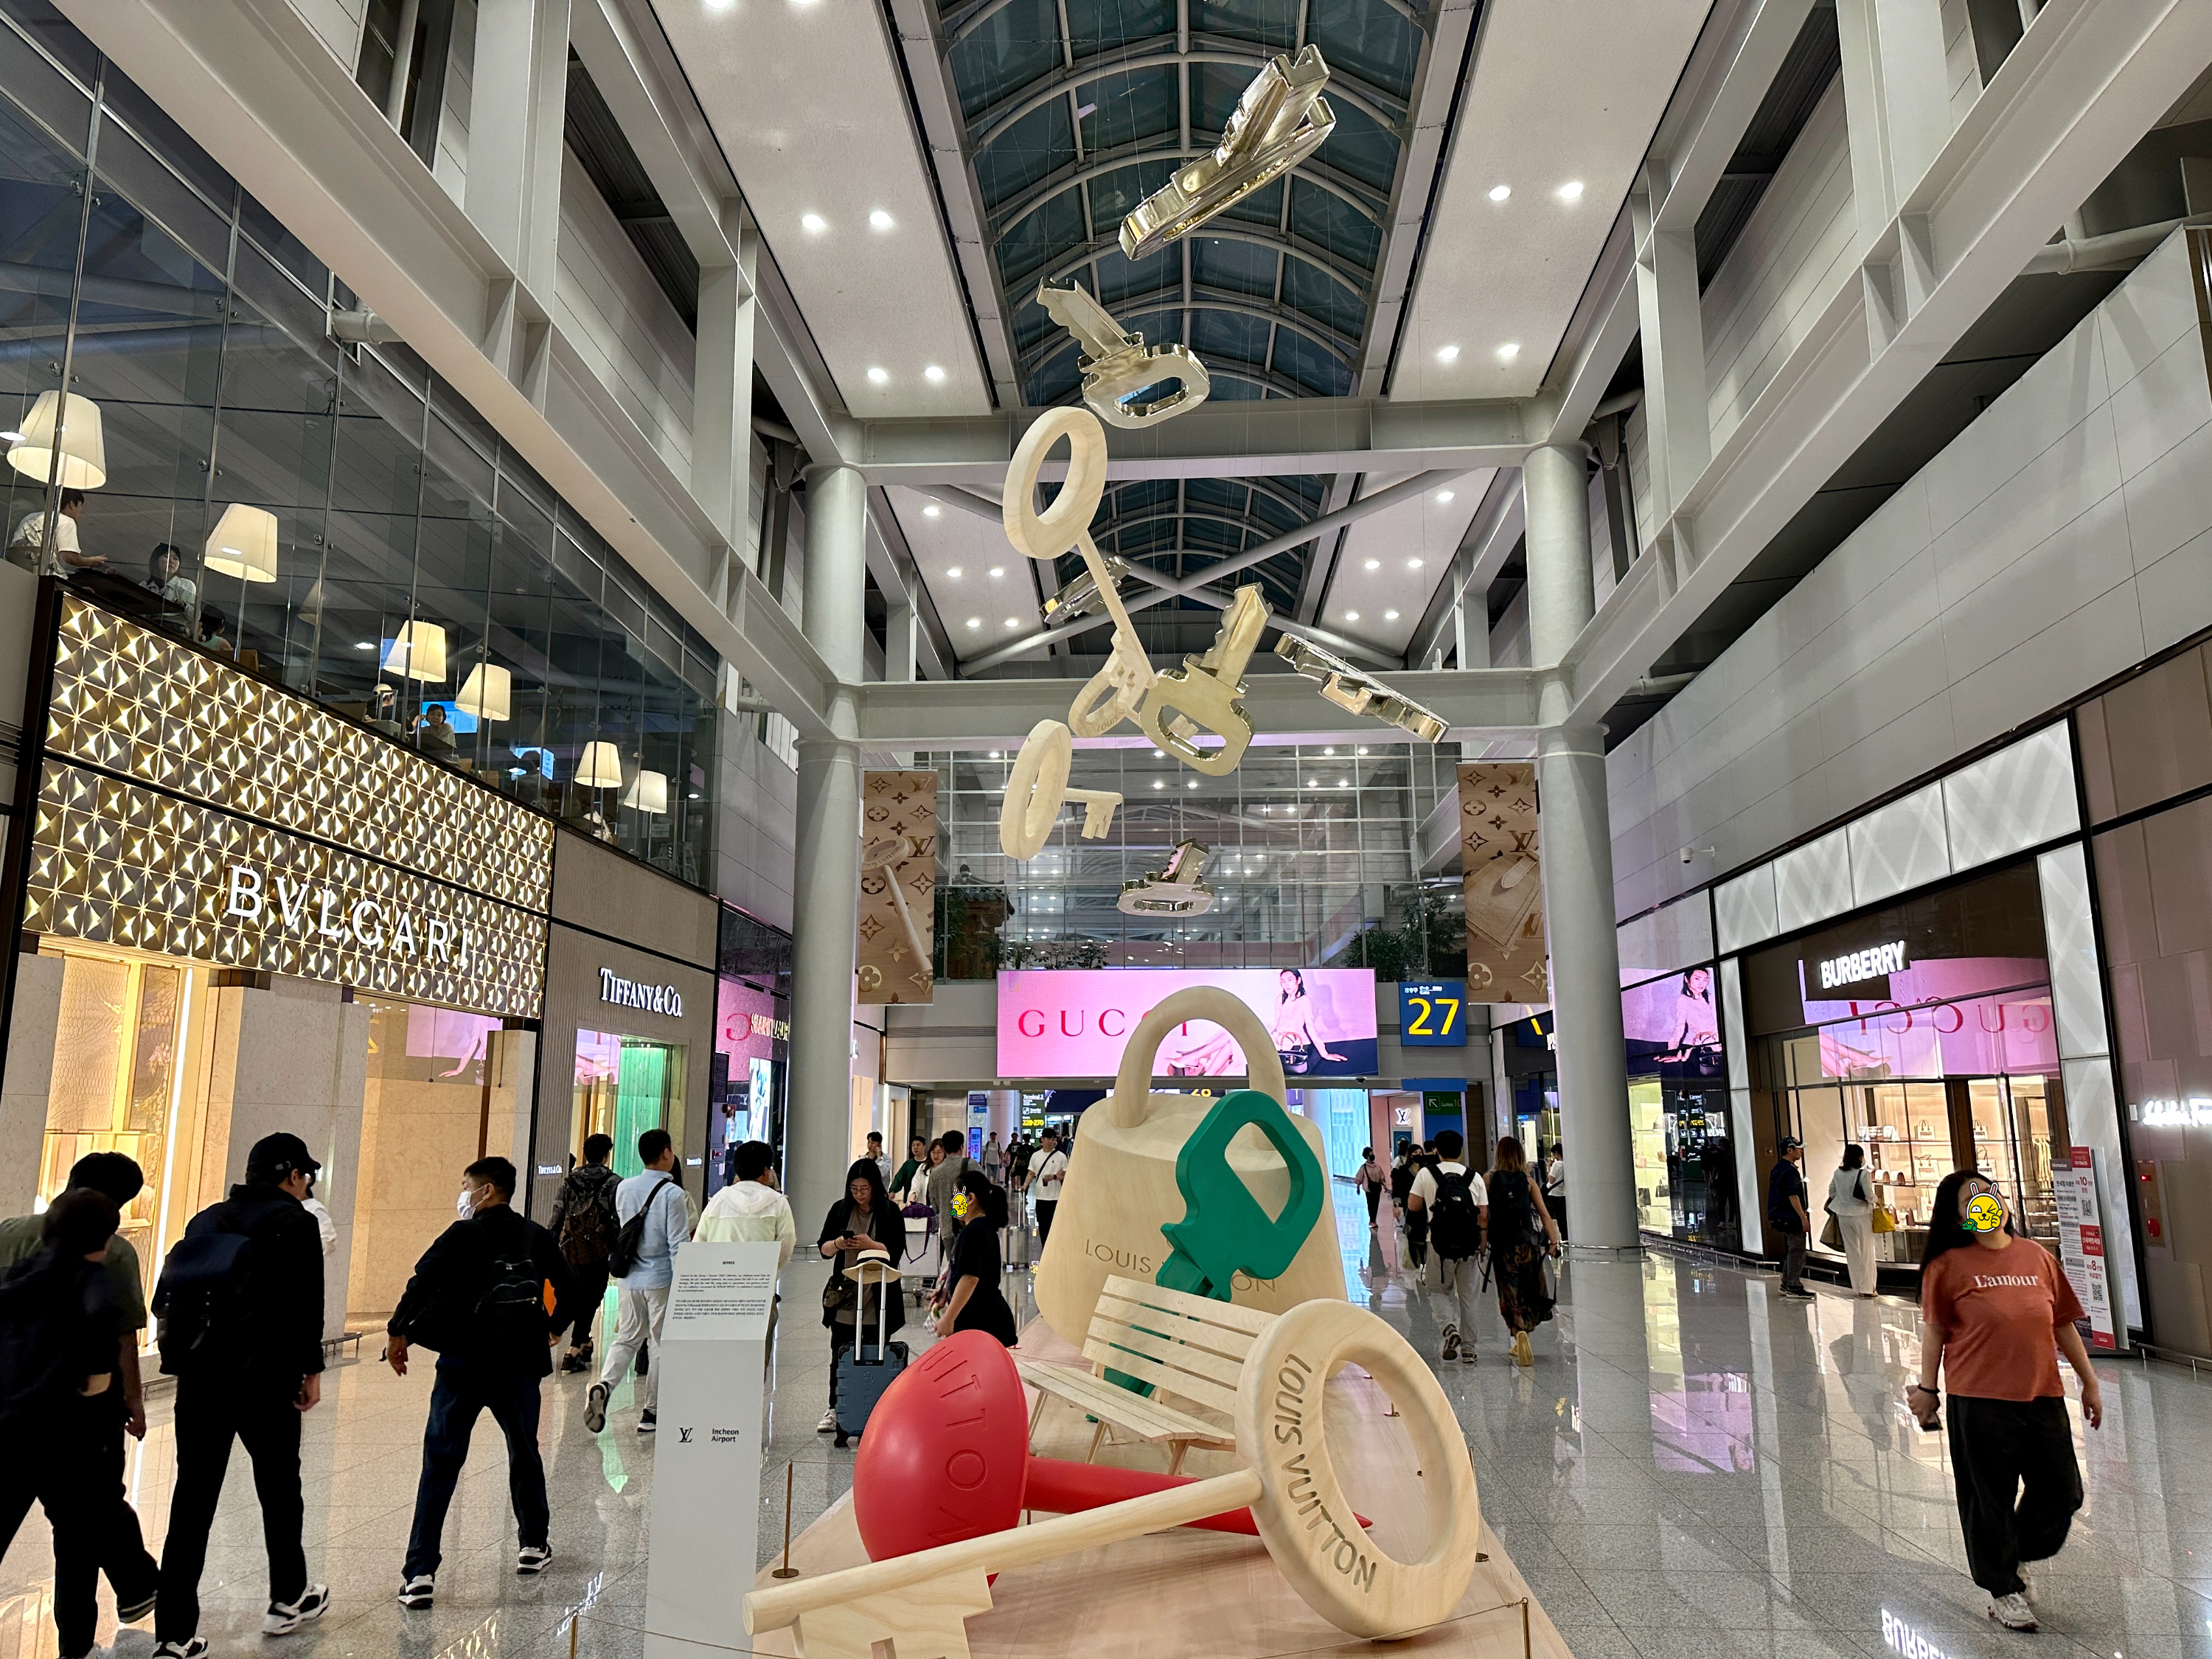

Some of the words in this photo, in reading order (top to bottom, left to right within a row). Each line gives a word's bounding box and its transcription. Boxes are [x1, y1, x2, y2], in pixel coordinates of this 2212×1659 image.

[226, 864, 470, 967] BVLGARI
[1820, 939, 1905, 990] BURBERRY
[1018, 1009, 1188, 1037] GUCI
[1408, 998, 1459, 1035] 27
[1085, 1238, 1152, 1275] LOUIS
[1973, 1274, 2038, 1289] L'amour
[1274, 1353, 1312, 1446] LOUIS
[678, 1427, 693, 1443] LV
[919, 1346, 989, 1543] UITTON
[1281, 1453, 1377, 1594] VUITTON
